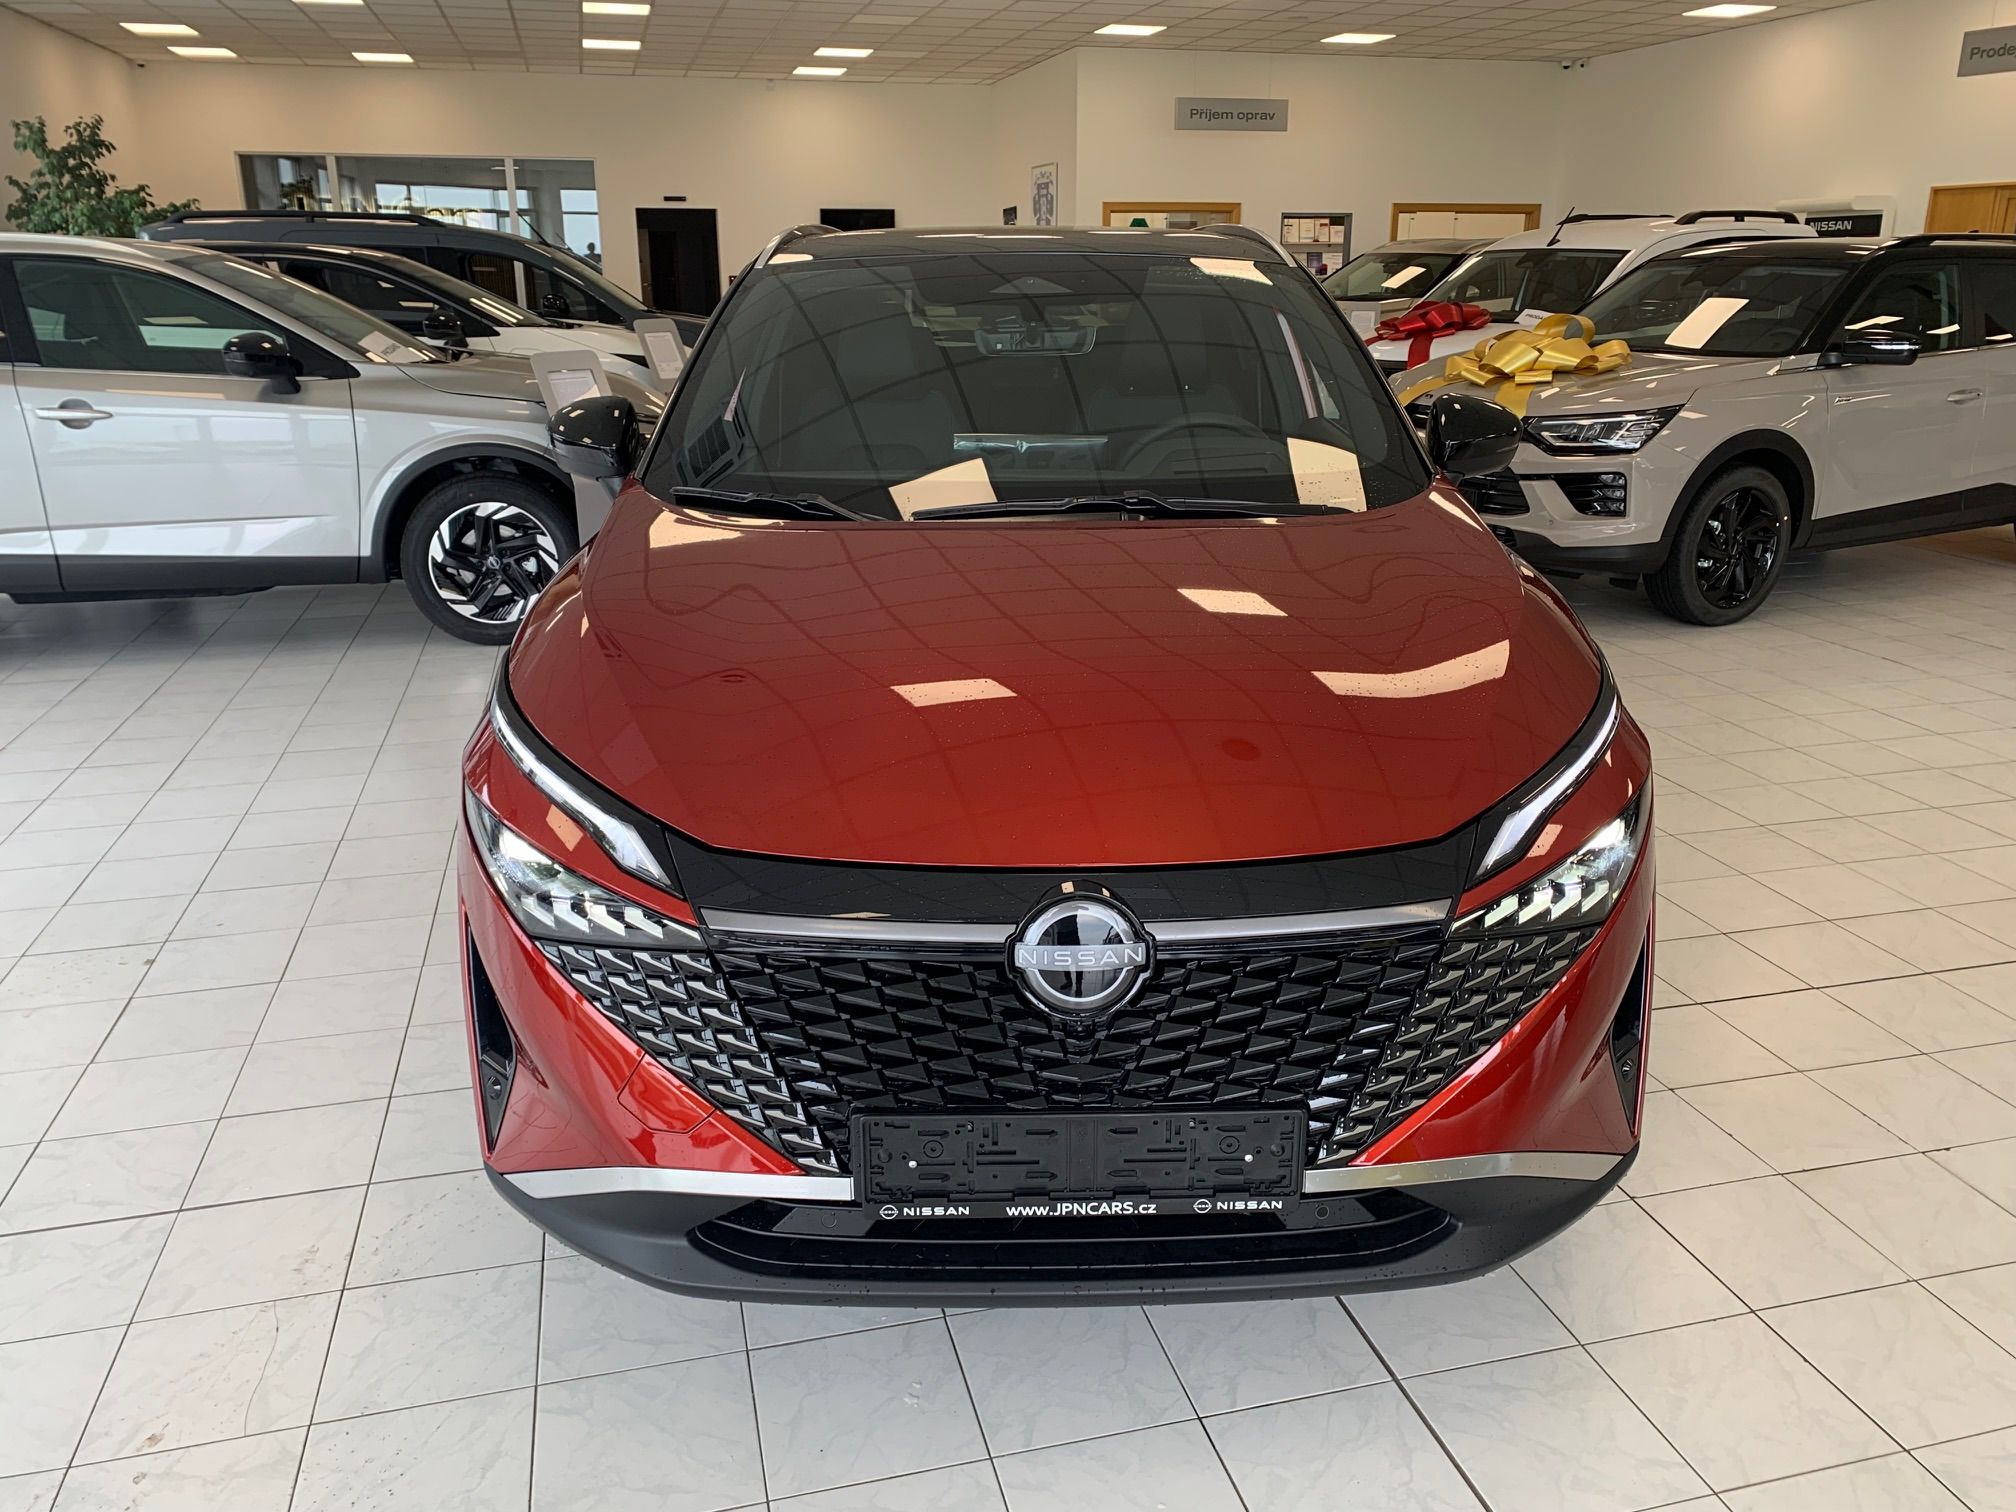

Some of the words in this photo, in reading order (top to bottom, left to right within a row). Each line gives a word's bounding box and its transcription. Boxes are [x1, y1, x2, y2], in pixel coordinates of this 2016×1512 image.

[1189, 108, 1234, 122] Příjem
[1236, 111, 1276, 122] oprav
[1809, 220, 1853, 231] NISSAN
[1018, 946, 1142, 966] NISSAN
[903, 1206, 970, 1216] NISSAN
[1005, 1201, 1157, 1216] www.JPNCARS.cz
[1216, 1200, 1283, 1210] NISSAN
